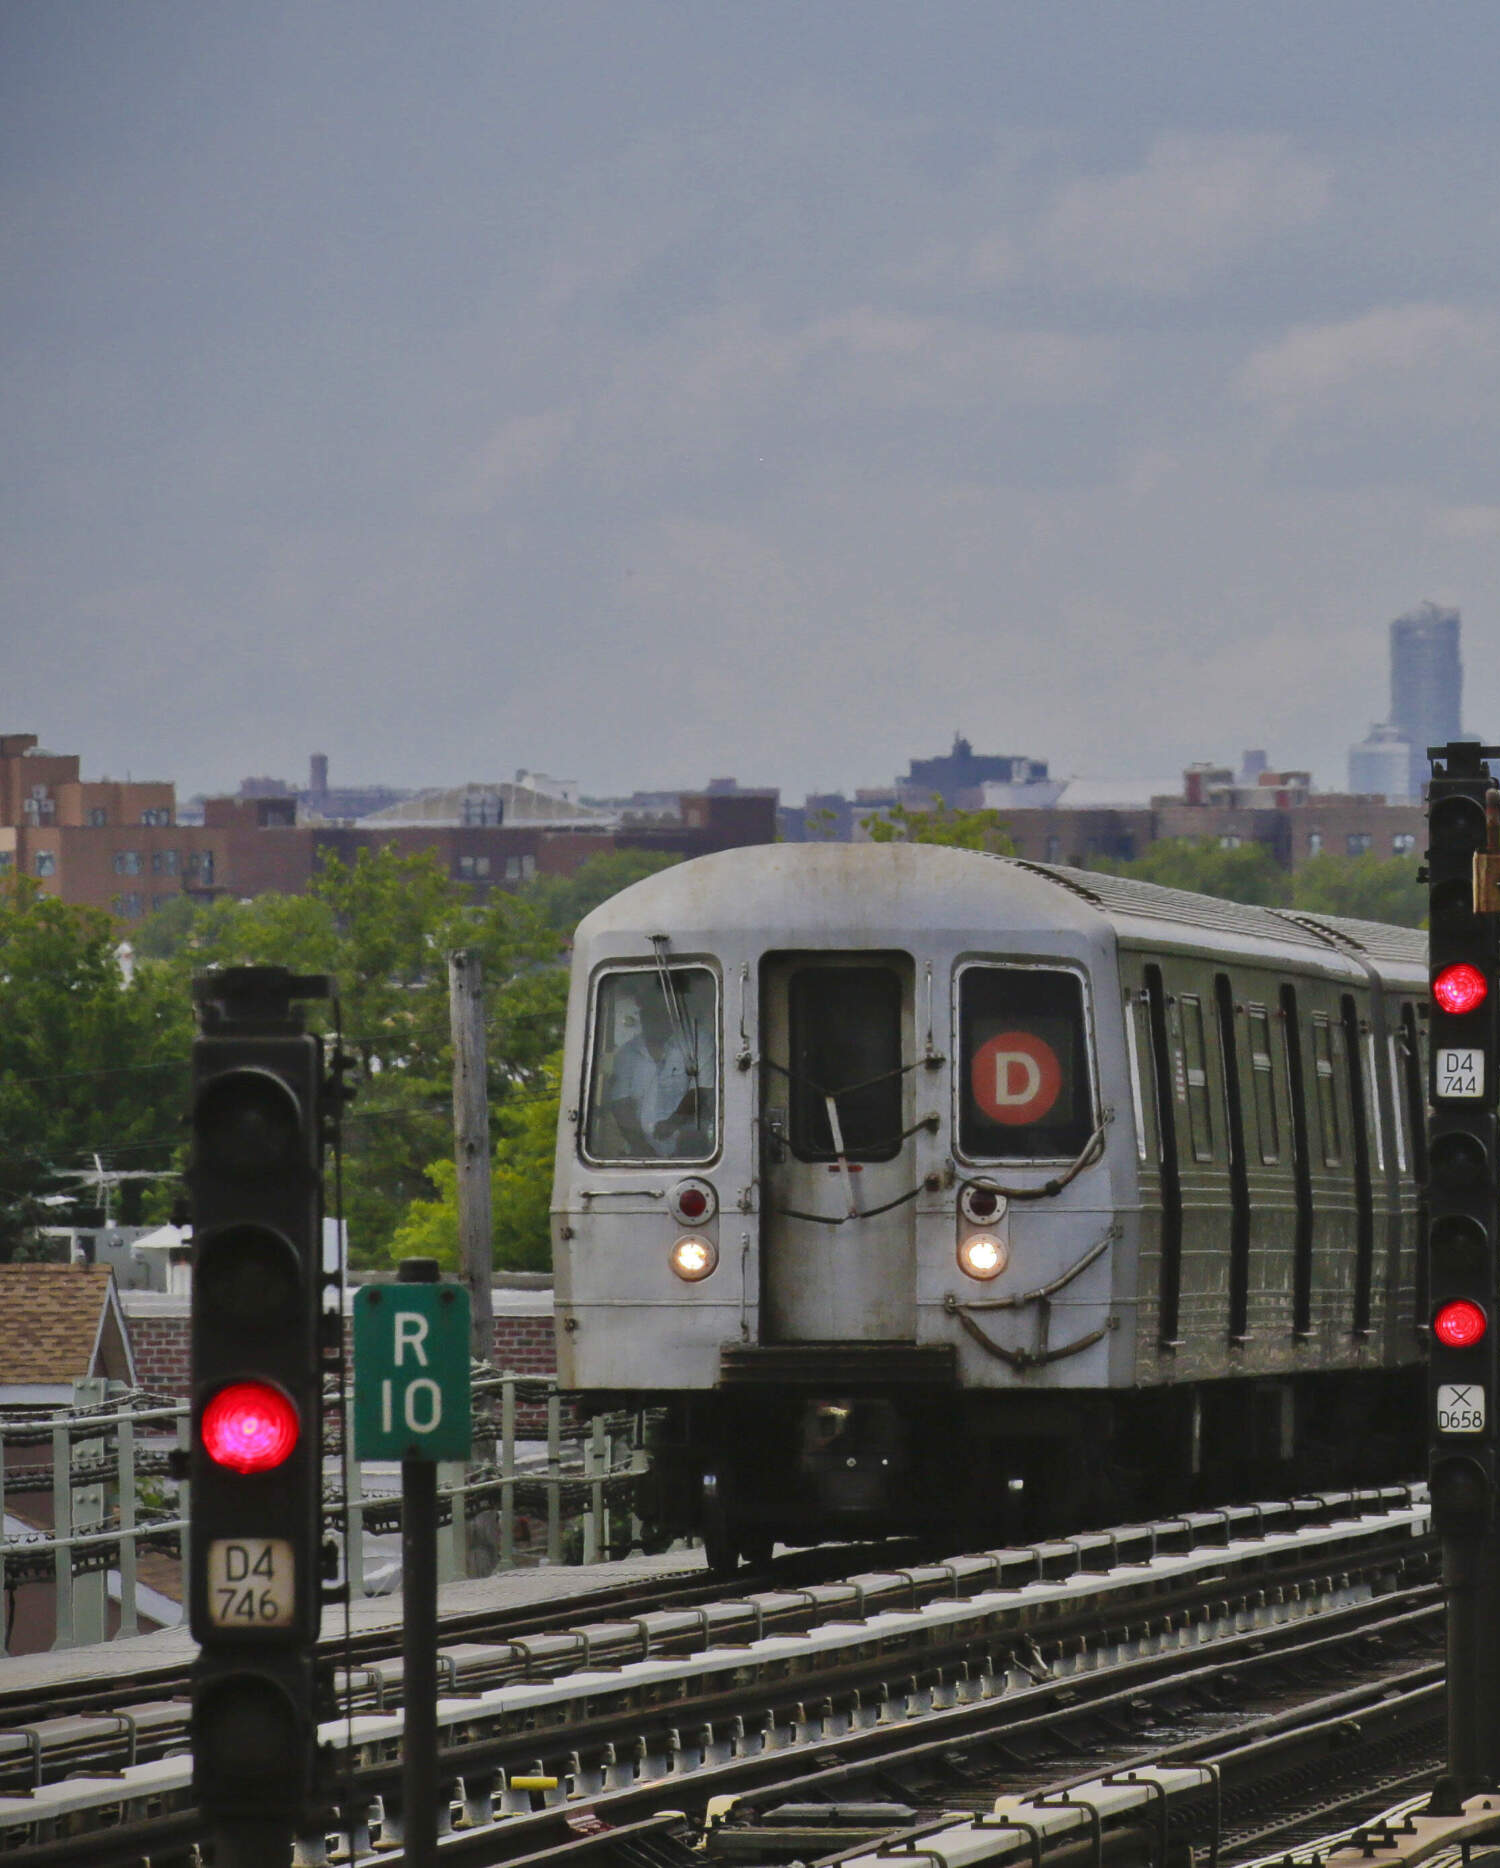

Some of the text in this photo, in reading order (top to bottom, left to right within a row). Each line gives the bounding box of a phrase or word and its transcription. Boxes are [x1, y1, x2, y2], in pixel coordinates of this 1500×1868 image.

[996, 1052, 1041, 1105] D
[1446, 1053, 1473, 1072] D4
[1443, 1076, 1476, 1094] 744
[394, 1311, 429, 1367] R
[381, 1377, 442, 1434] 10
[1440, 1410, 1483, 1429] D658
[226, 1544, 274, 1582] D4
[217, 1588, 278, 1621] 746
